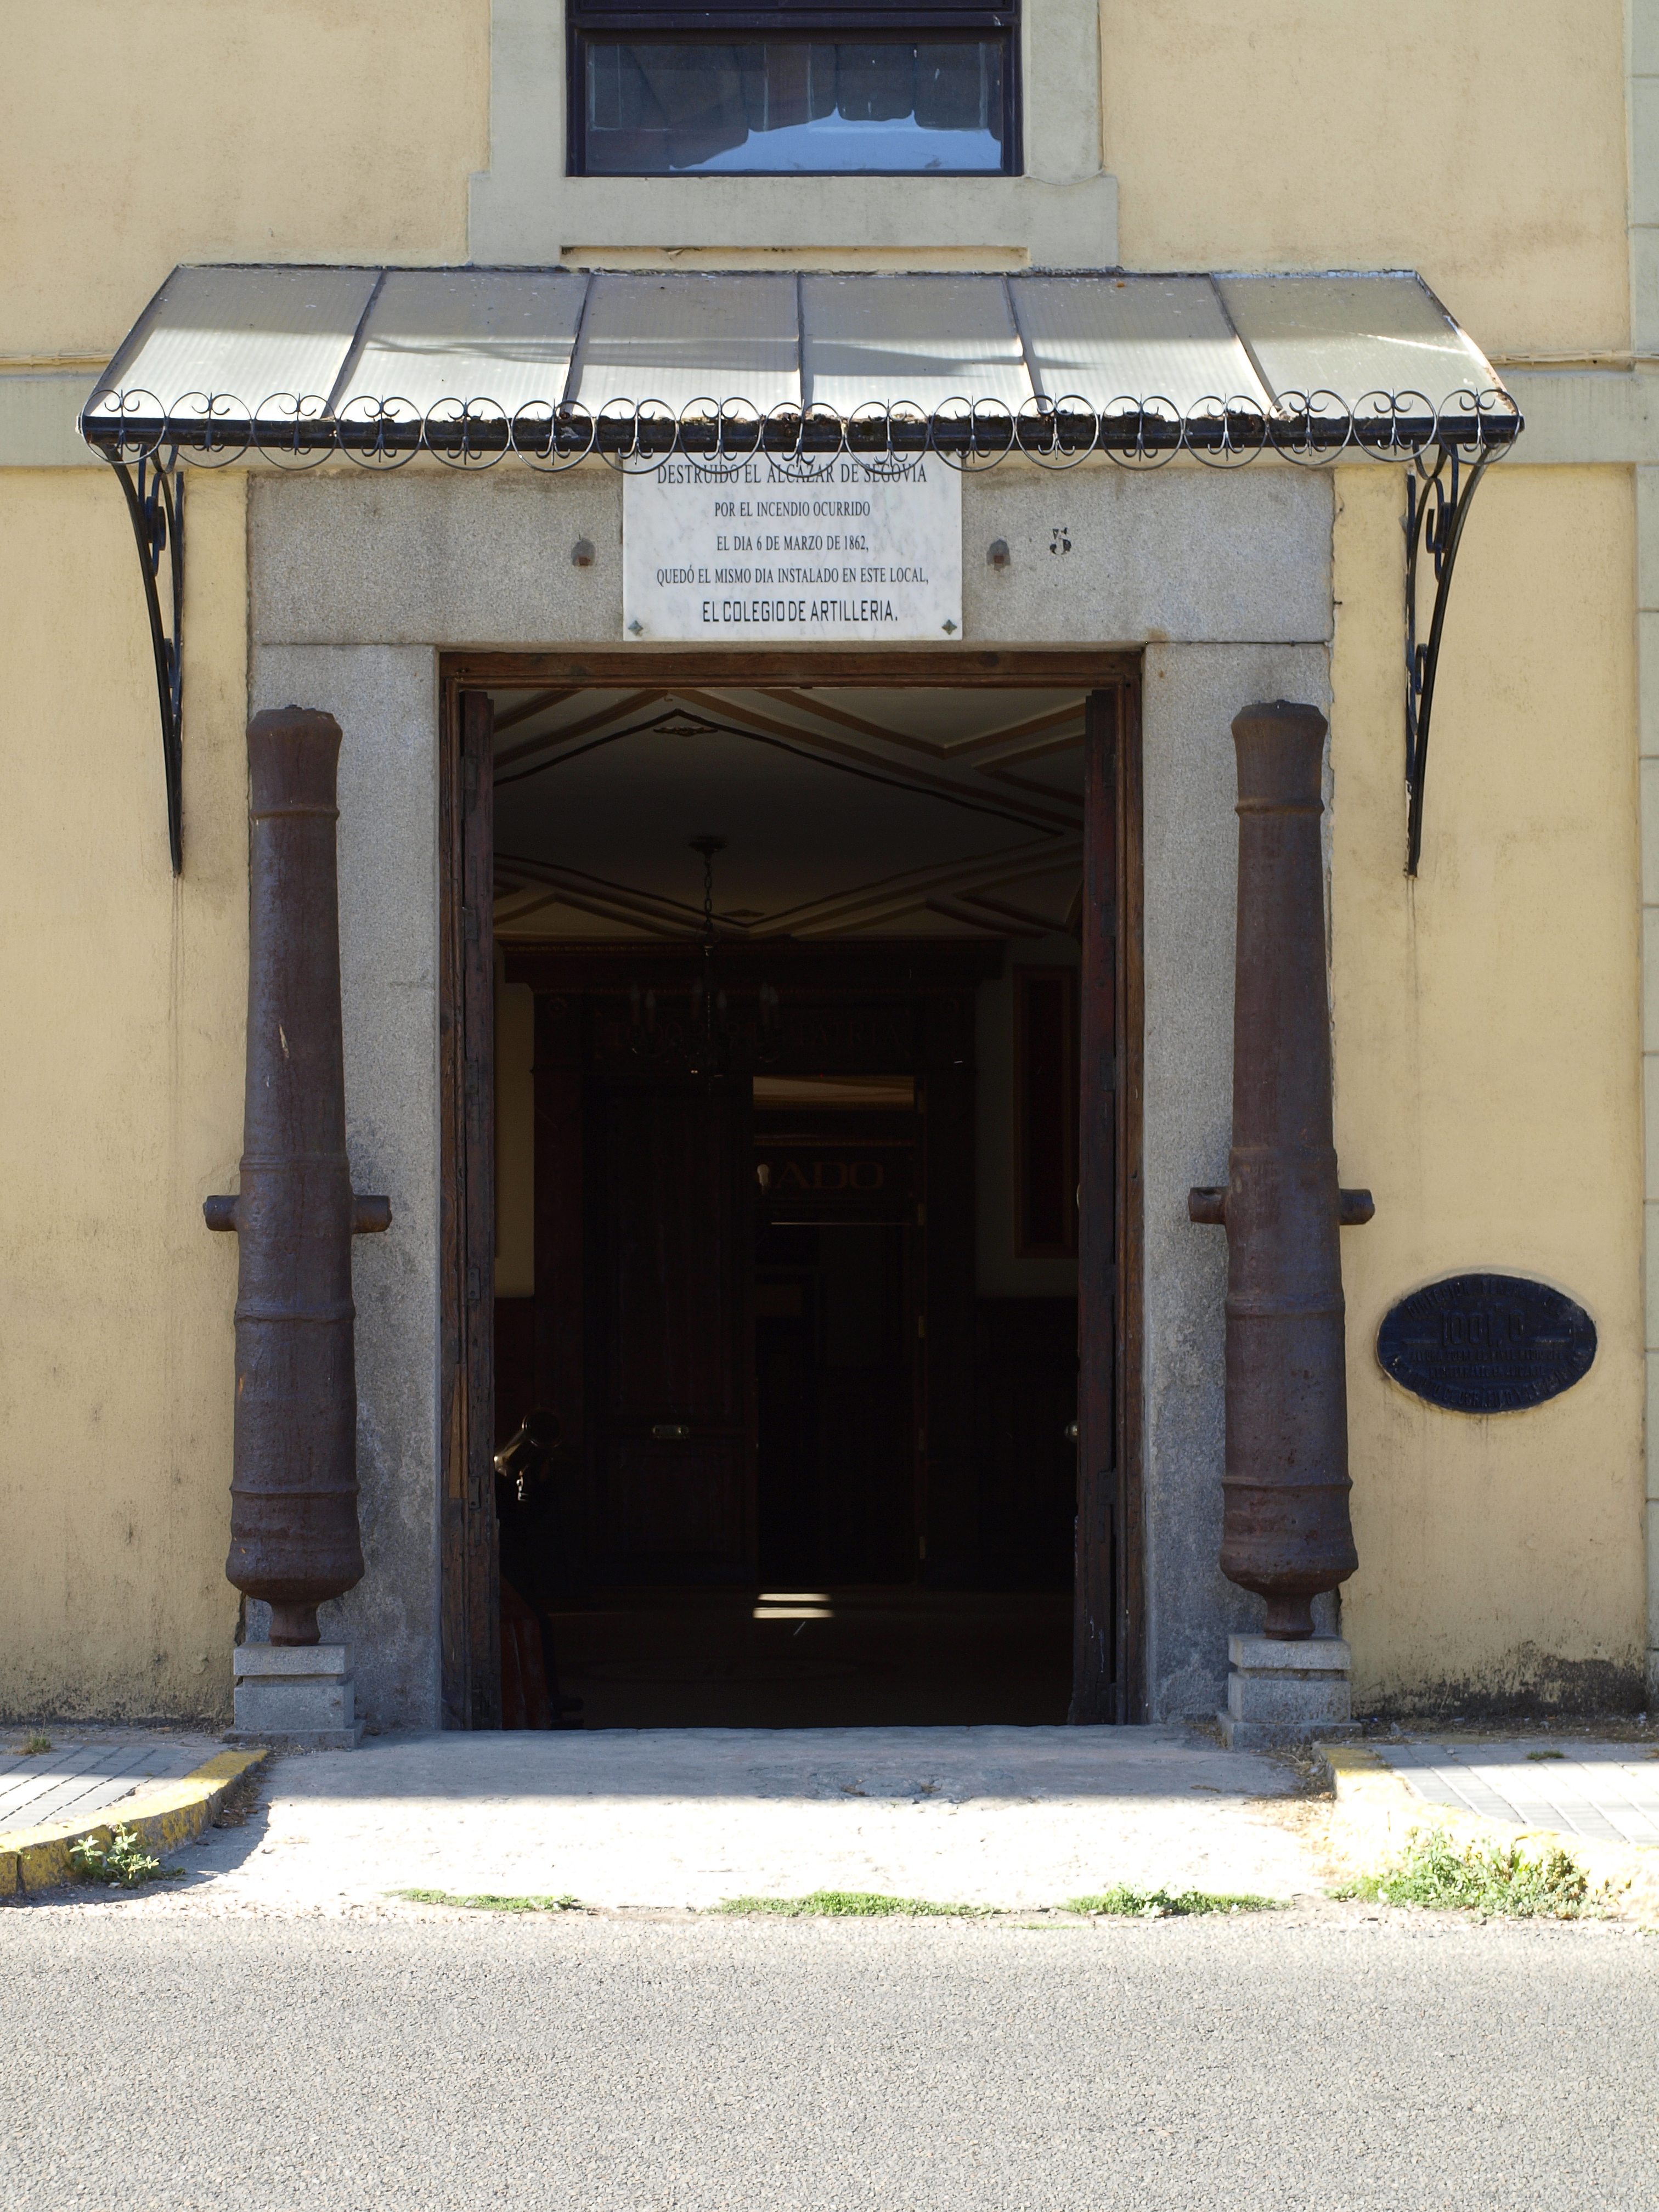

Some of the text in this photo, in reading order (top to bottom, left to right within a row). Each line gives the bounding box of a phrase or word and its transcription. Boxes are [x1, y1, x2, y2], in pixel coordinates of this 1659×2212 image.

[657, 462, 927, 484] DESTRUIDO EL ALCAZAR DE SEGOVIA
[714, 500, 871, 517] POR EL INCENDIO OCURRIDO
[716, 534, 869, 552] EL DIA 6 DE MARZO DE 1862,
[1049, 527, 1072, 555] 5
[656, 564, 929, 588] QUEDÓ EL MISMO DIA INSTALADO EN ESTE LOCAL,
[703, 600, 898, 622] EL COLEGIO DE ARTILLERIA.
[798, 1022, 901, 1046] PATRIA
